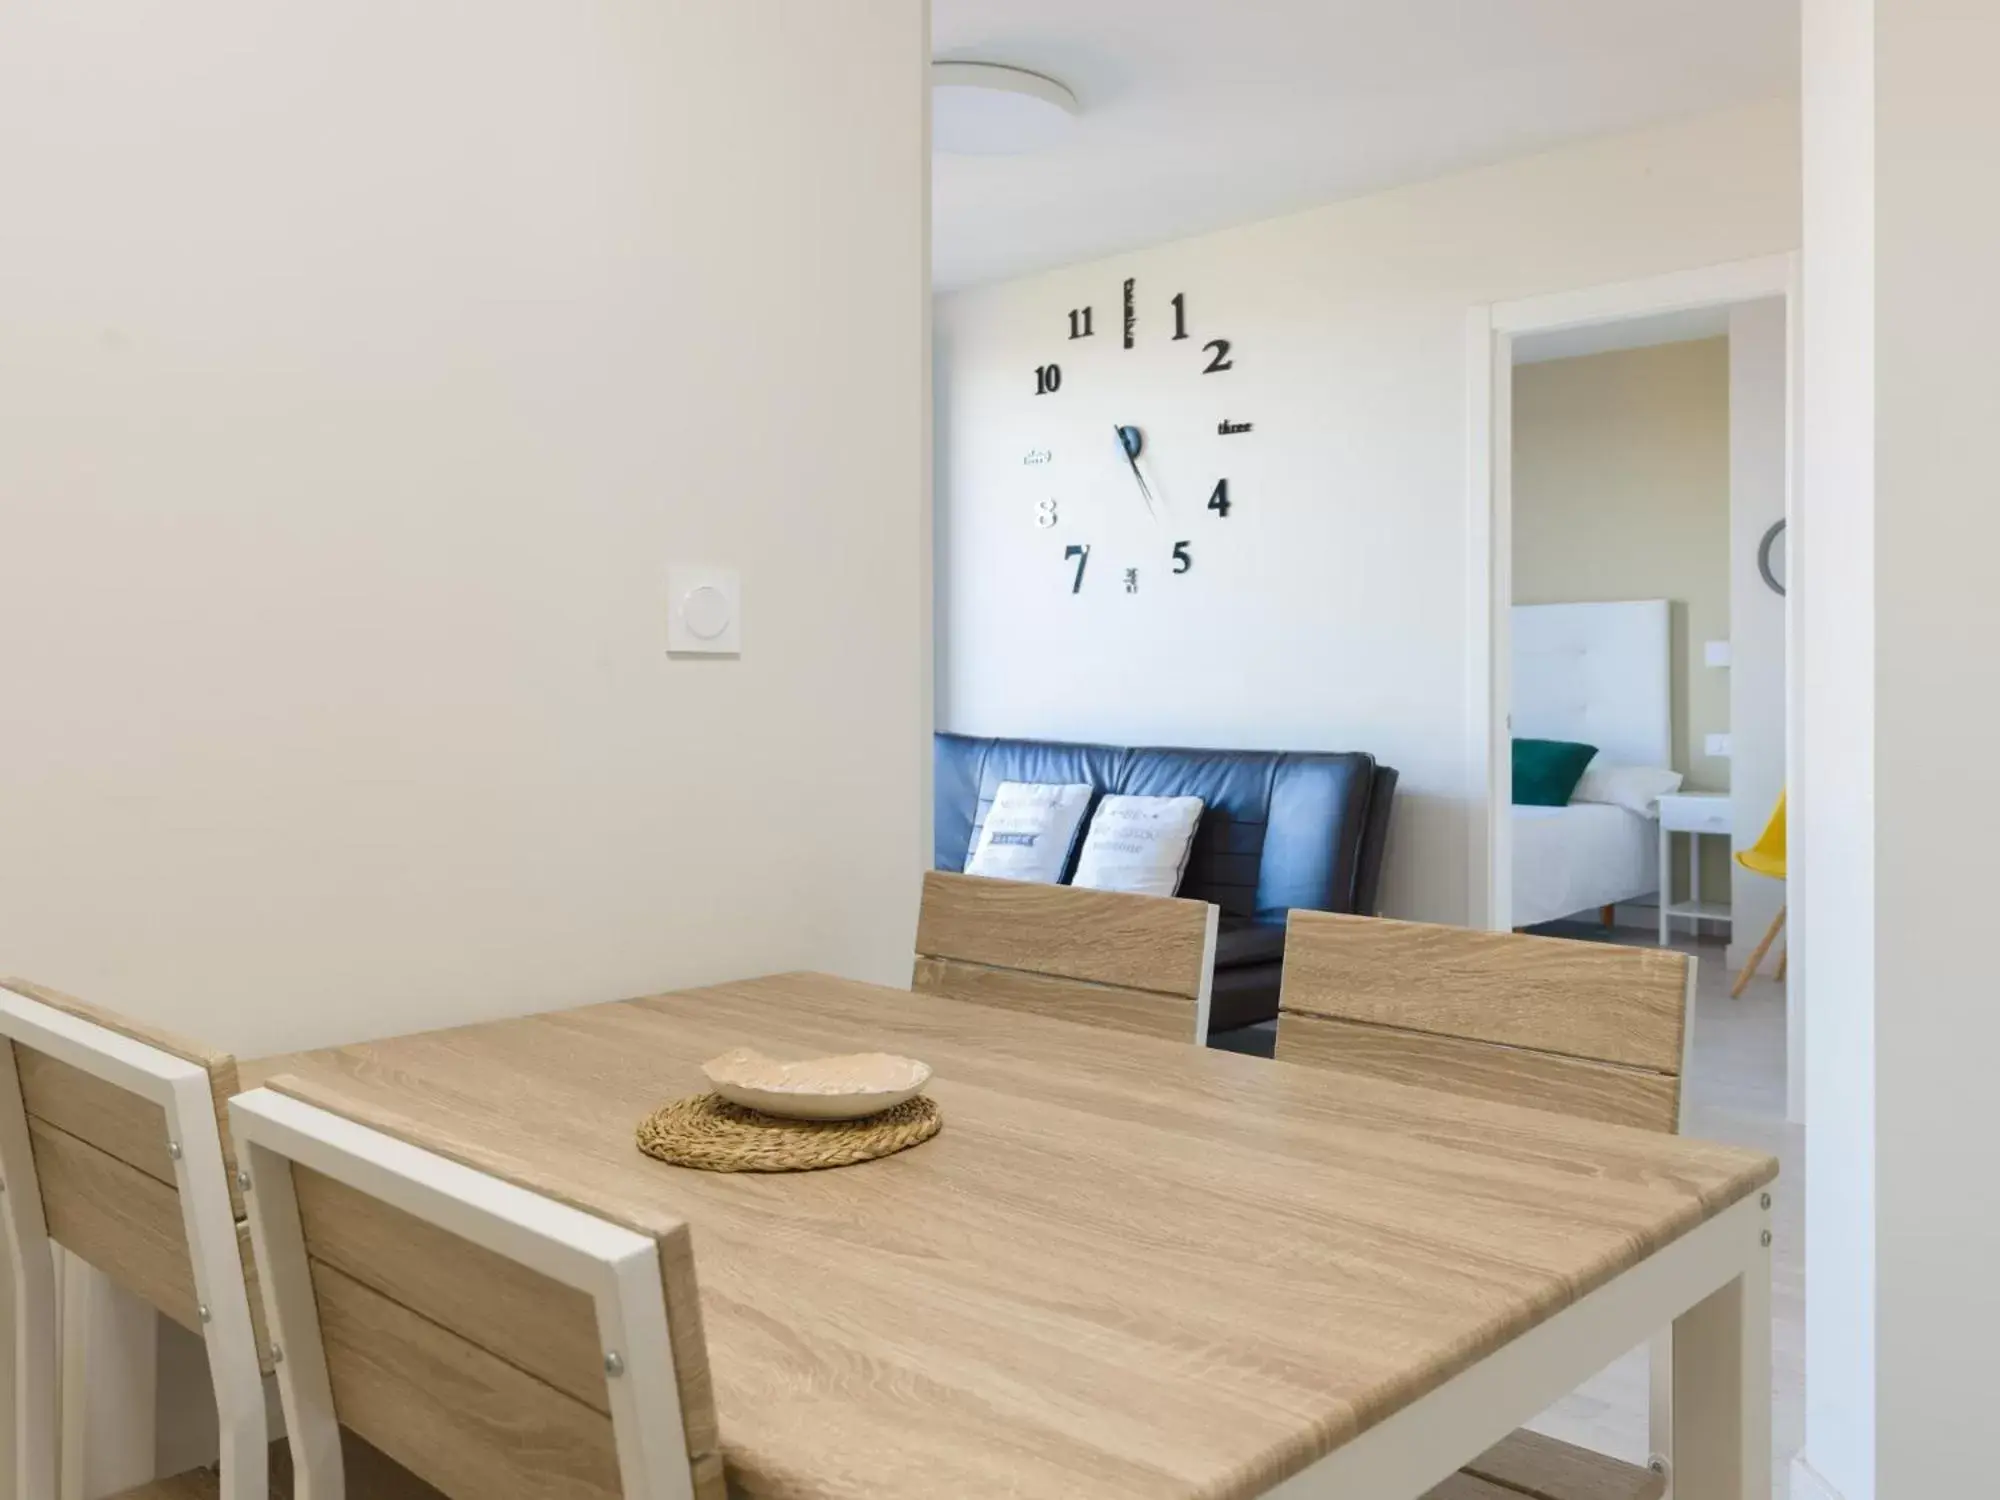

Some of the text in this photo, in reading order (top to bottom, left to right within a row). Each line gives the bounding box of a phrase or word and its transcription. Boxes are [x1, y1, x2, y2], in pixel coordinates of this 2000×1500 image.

[1067, 306, 1095, 340] 11
[1170, 292, 1190, 341] 1
[1201, 339, 1233, 374] 2
[1034, 363, 1062, 395] 10
[1034, 497, 1059, 529] 8
[1206, 478, 1233, 518] 4
[1063, 544, 1091, 595] 7
[1171, 540, 1193, 575] 5
